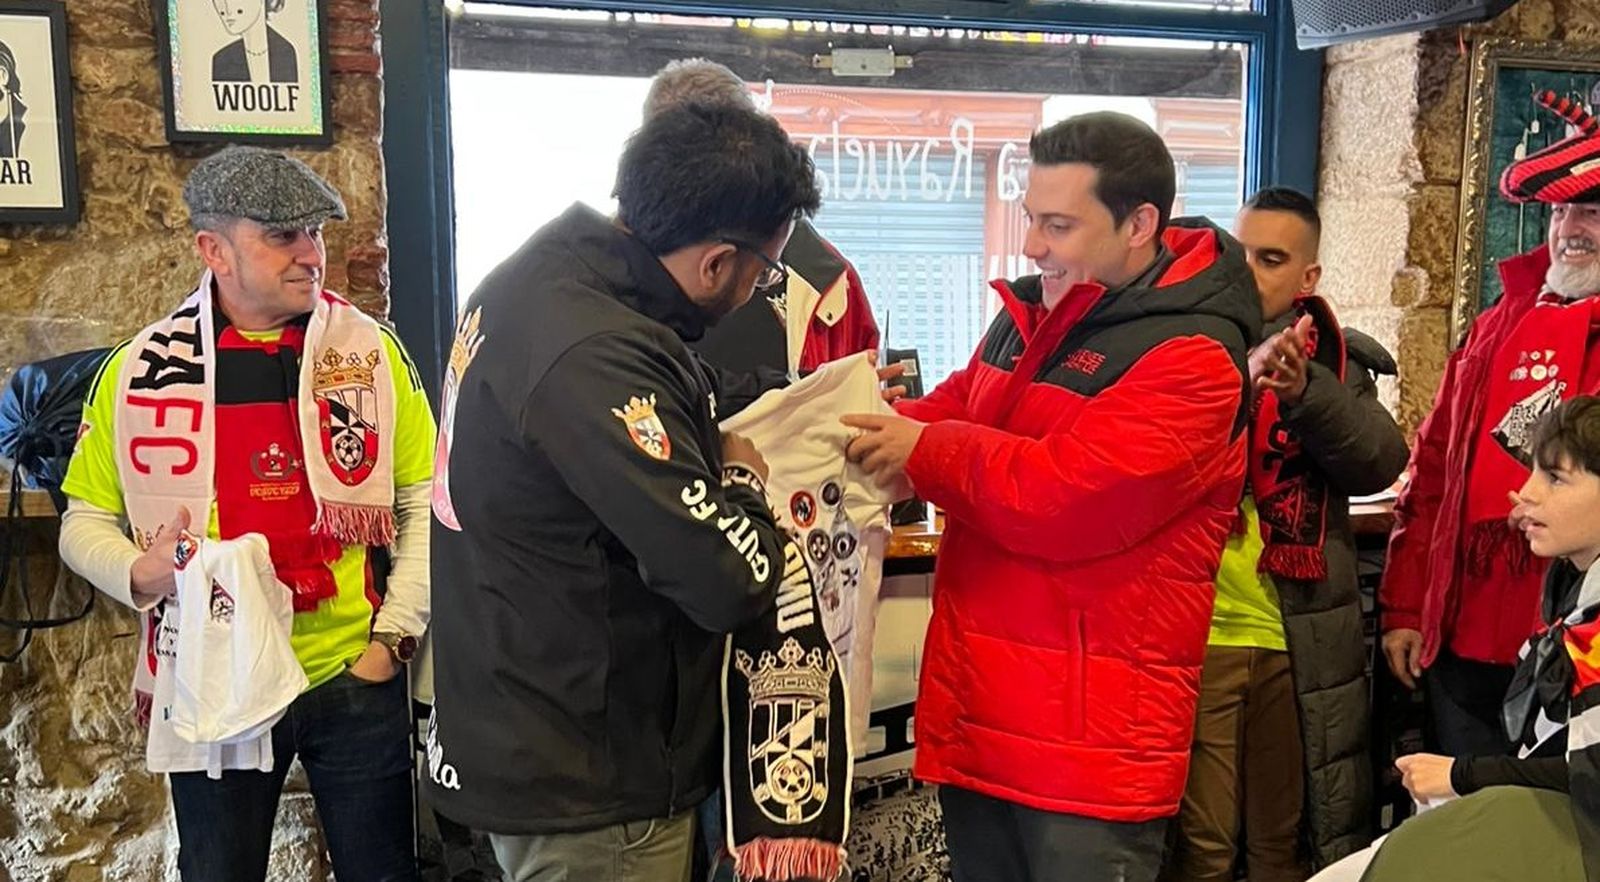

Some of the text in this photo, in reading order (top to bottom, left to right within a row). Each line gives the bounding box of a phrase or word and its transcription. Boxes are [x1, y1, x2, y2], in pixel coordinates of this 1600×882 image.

[212, 83, 300, 113] WOOLF
[126, 394, 204, 475] FC
[680, 479, 718, 521] FC
